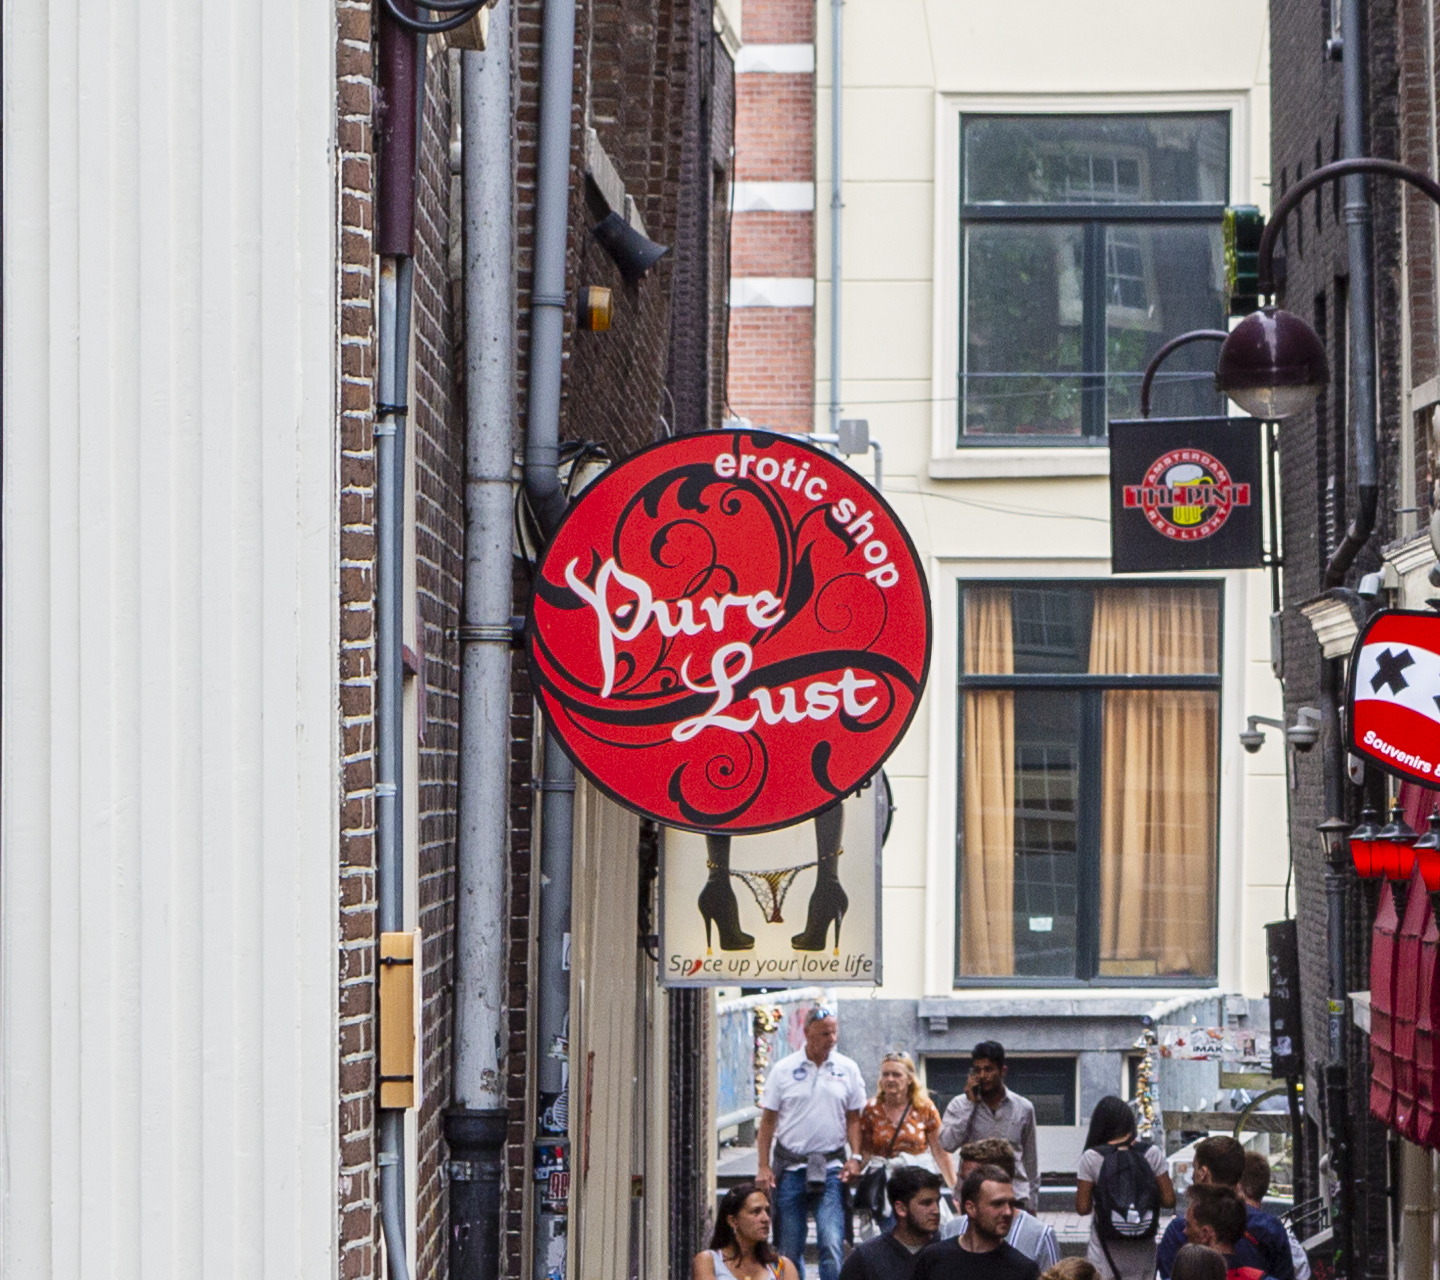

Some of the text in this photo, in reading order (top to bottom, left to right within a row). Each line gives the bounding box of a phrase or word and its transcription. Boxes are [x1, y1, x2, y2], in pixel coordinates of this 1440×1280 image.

[1148, 451, 1227, 483] AMSTERDAM
[1131, 486, 1243, 506] THE PINT
[714, 451, 900, 589] erotic shop
[565, 556, 785, 699] Pure
[672, 642, 878, 742] Lust
[1363, 730, 1432, 773] Souvenirs
[728, 958, 750, 977] up
[754, 958, 798, 977] your
[801, 954, 840, 972] love
[844, 954, 873, 977] life
